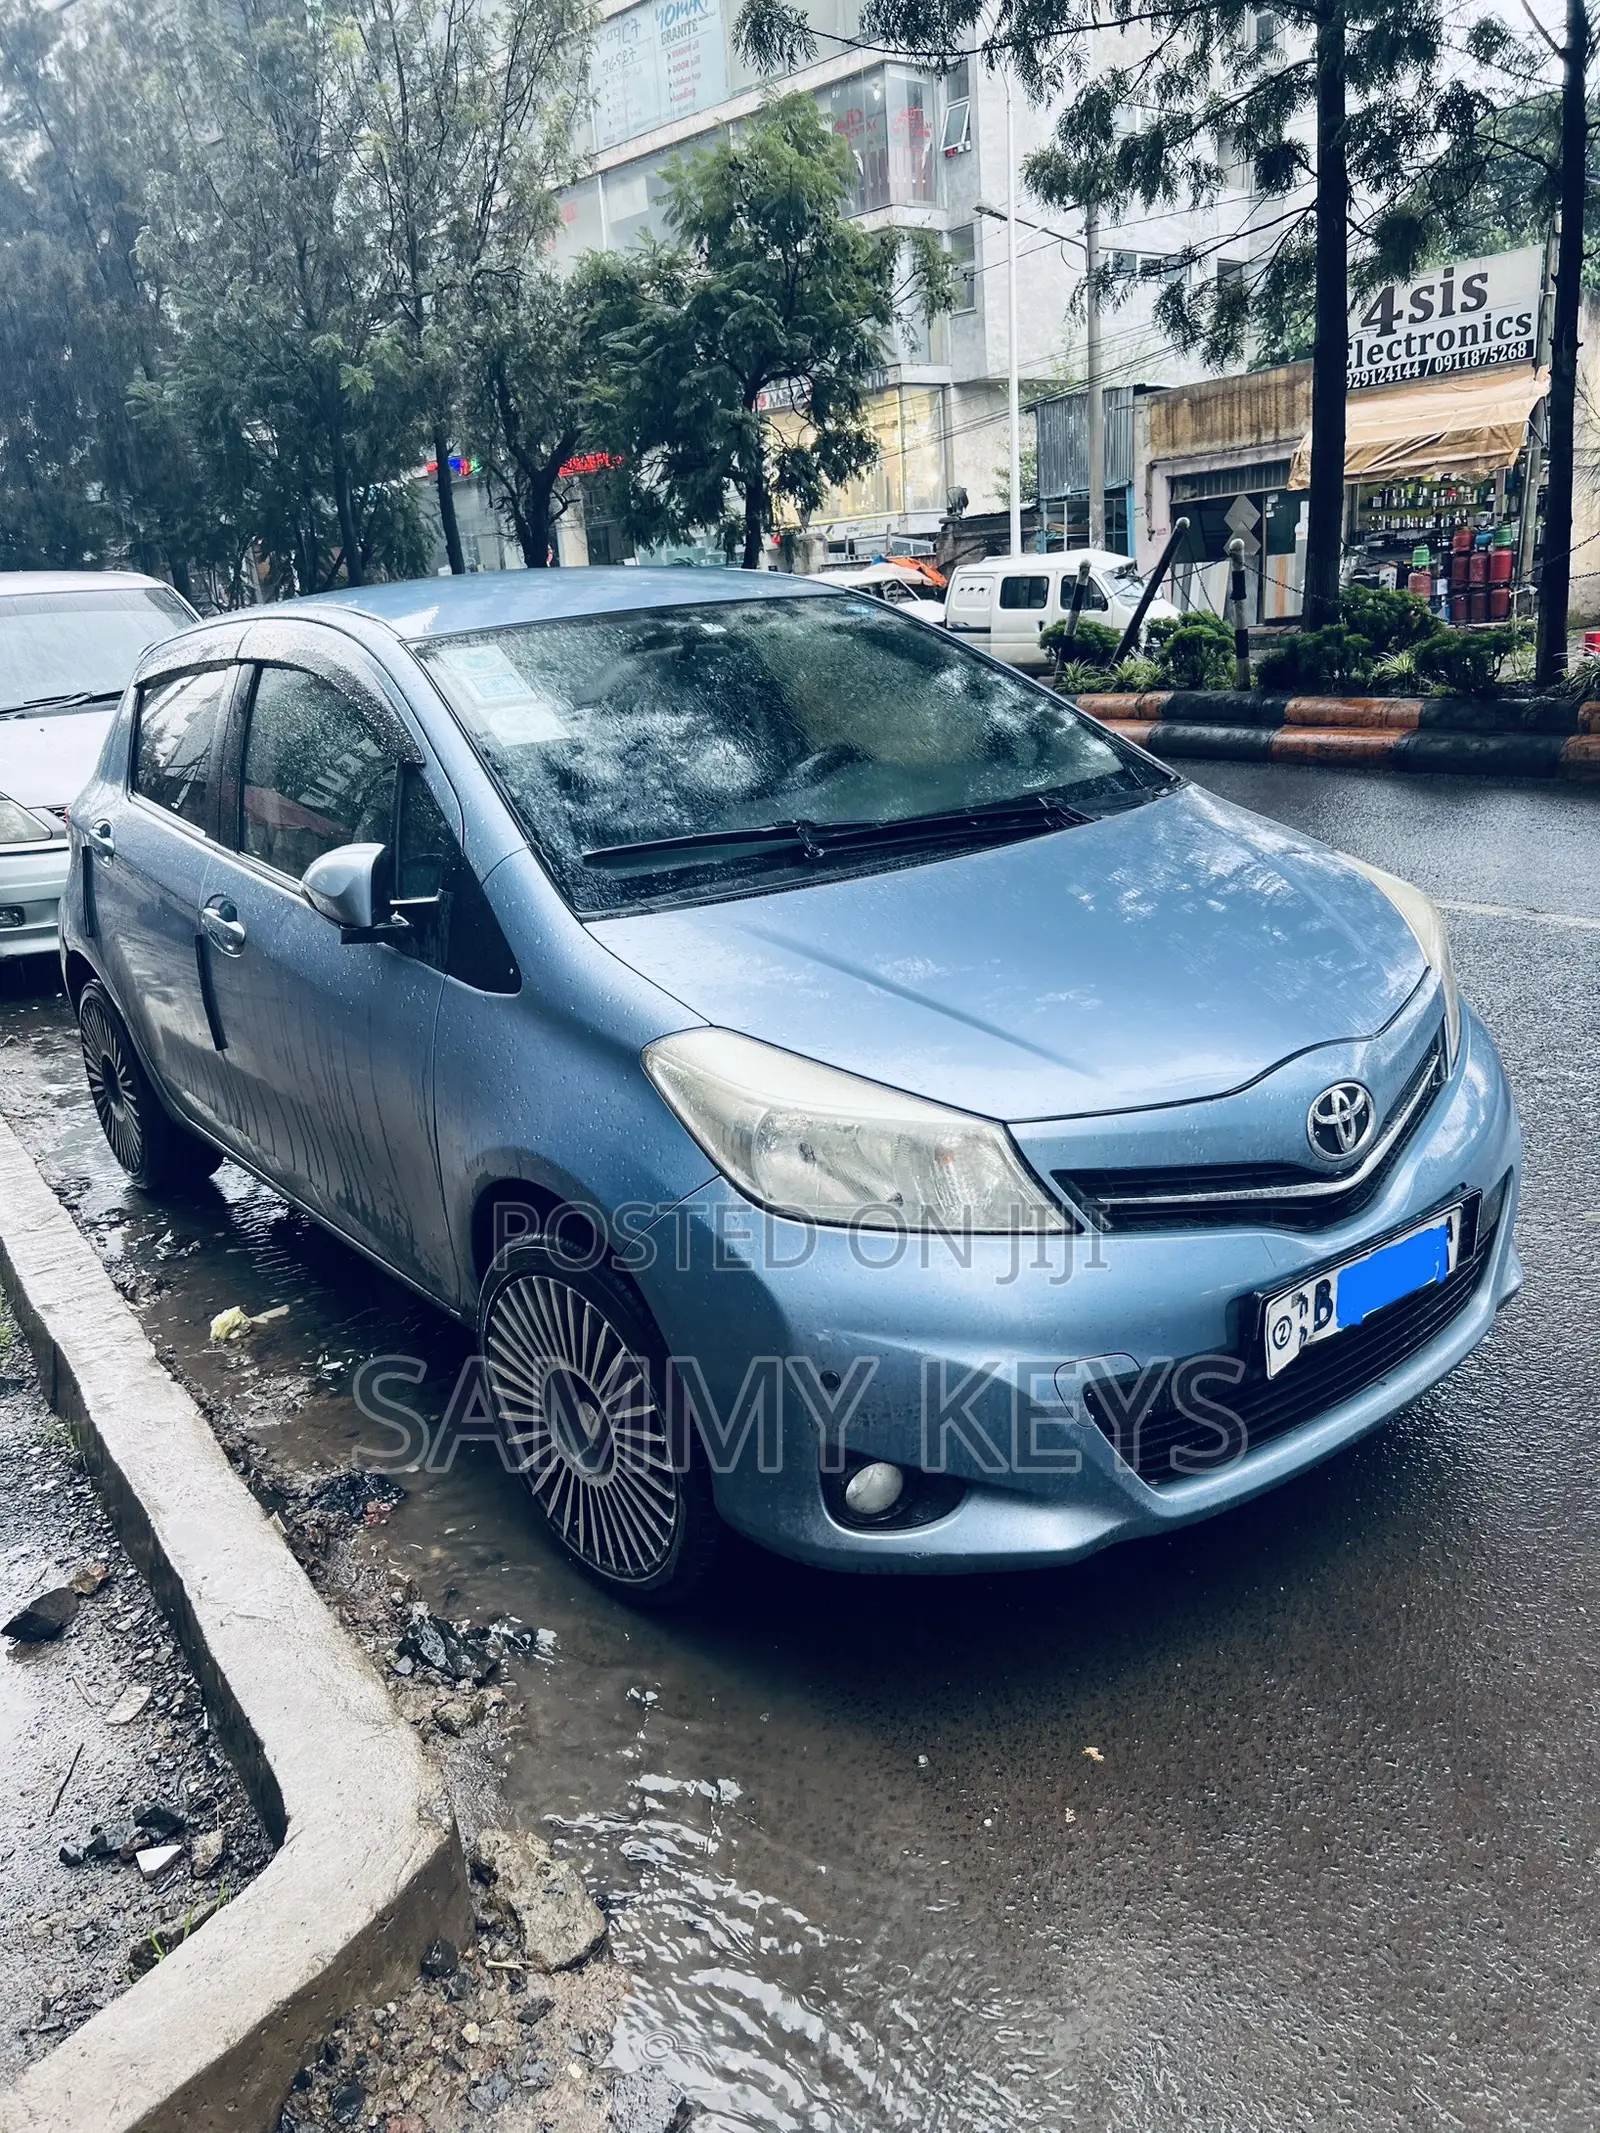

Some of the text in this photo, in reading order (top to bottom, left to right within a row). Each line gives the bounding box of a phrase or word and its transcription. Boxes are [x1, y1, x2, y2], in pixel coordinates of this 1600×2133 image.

[660, 18, 698, 45] GRANITE
[1360, 267, 1489, 338] 4sis
[1434, 341, 1528, 374] 0911875268
